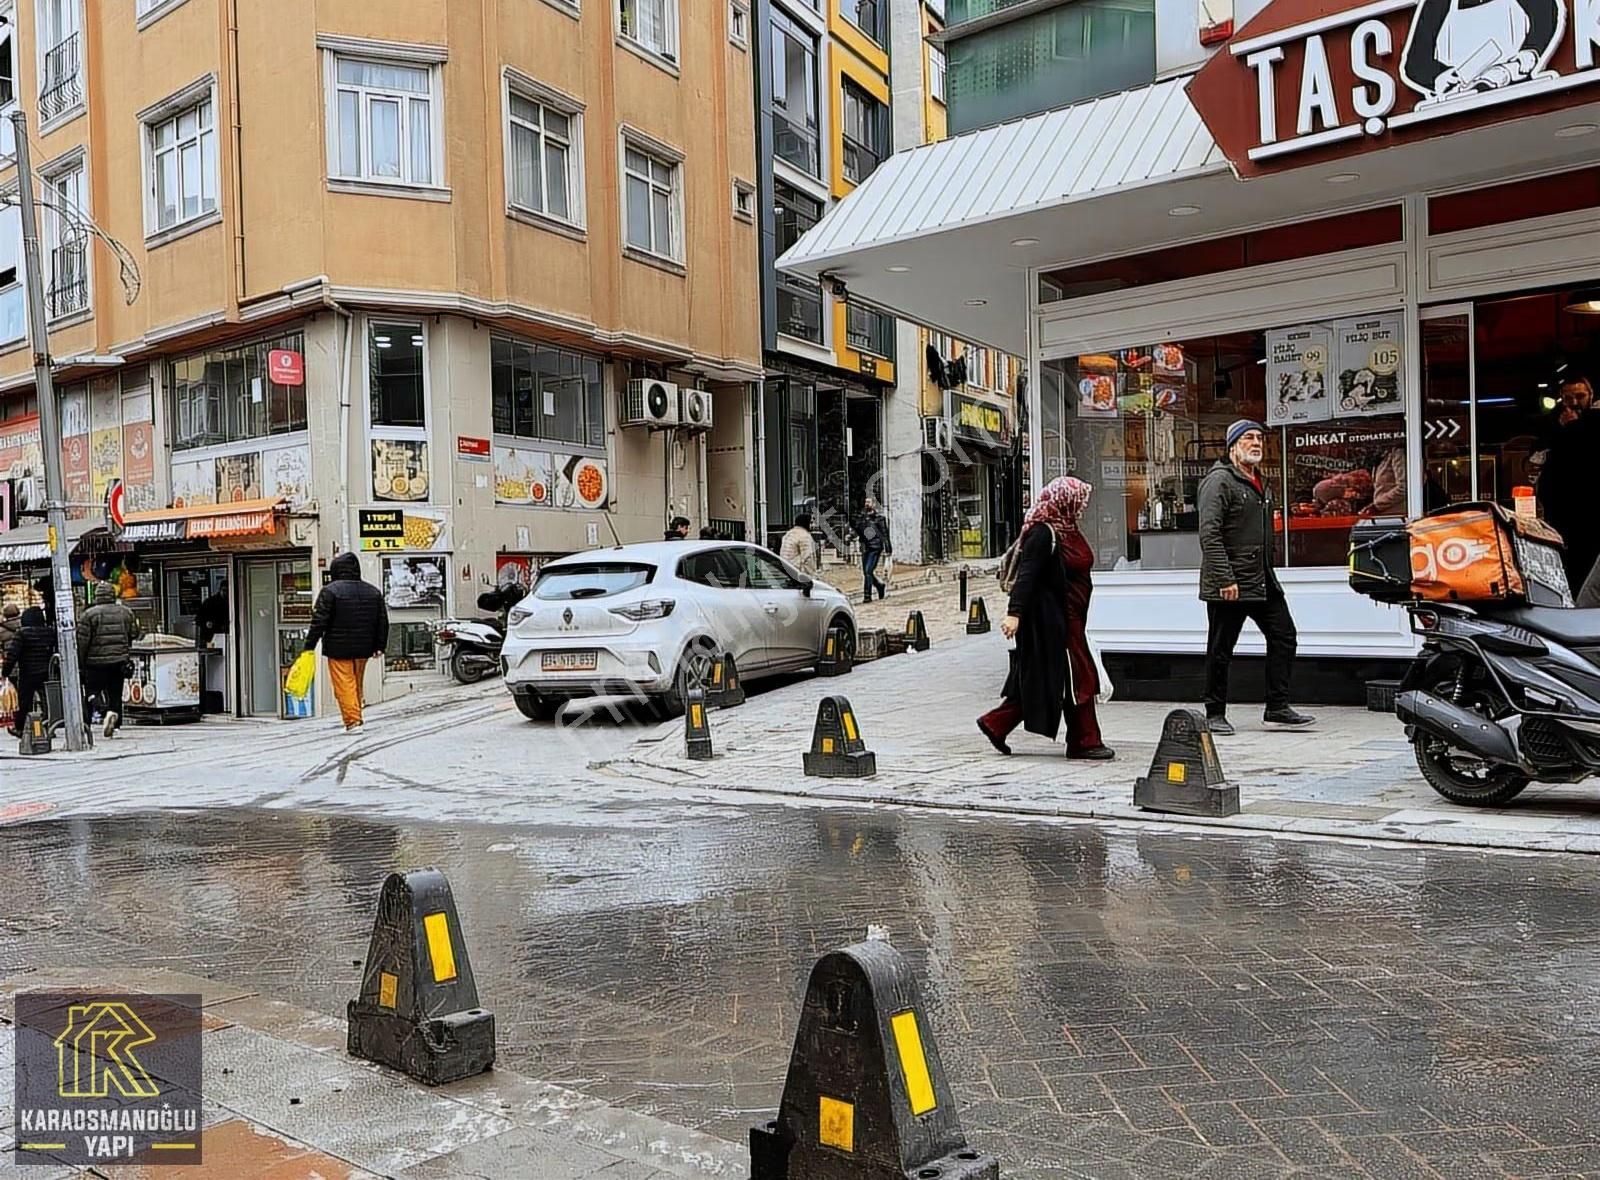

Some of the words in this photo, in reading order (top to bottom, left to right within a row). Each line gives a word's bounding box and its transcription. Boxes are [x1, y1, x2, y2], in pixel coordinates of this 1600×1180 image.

[1247, 18, 1397, 144] TAŞ
[1306, 350, 1320, 361] 99
[1374, 350, 1398, 366] 105
[1295, 432, 1347, 447] DİKKAT
[1393, 431, 1407, 440] KA
[373, 513, 396, 522] TEPSİ
[362, 523, 402, 531] BAKLAVA
[385, 539, 399, 548] TL
